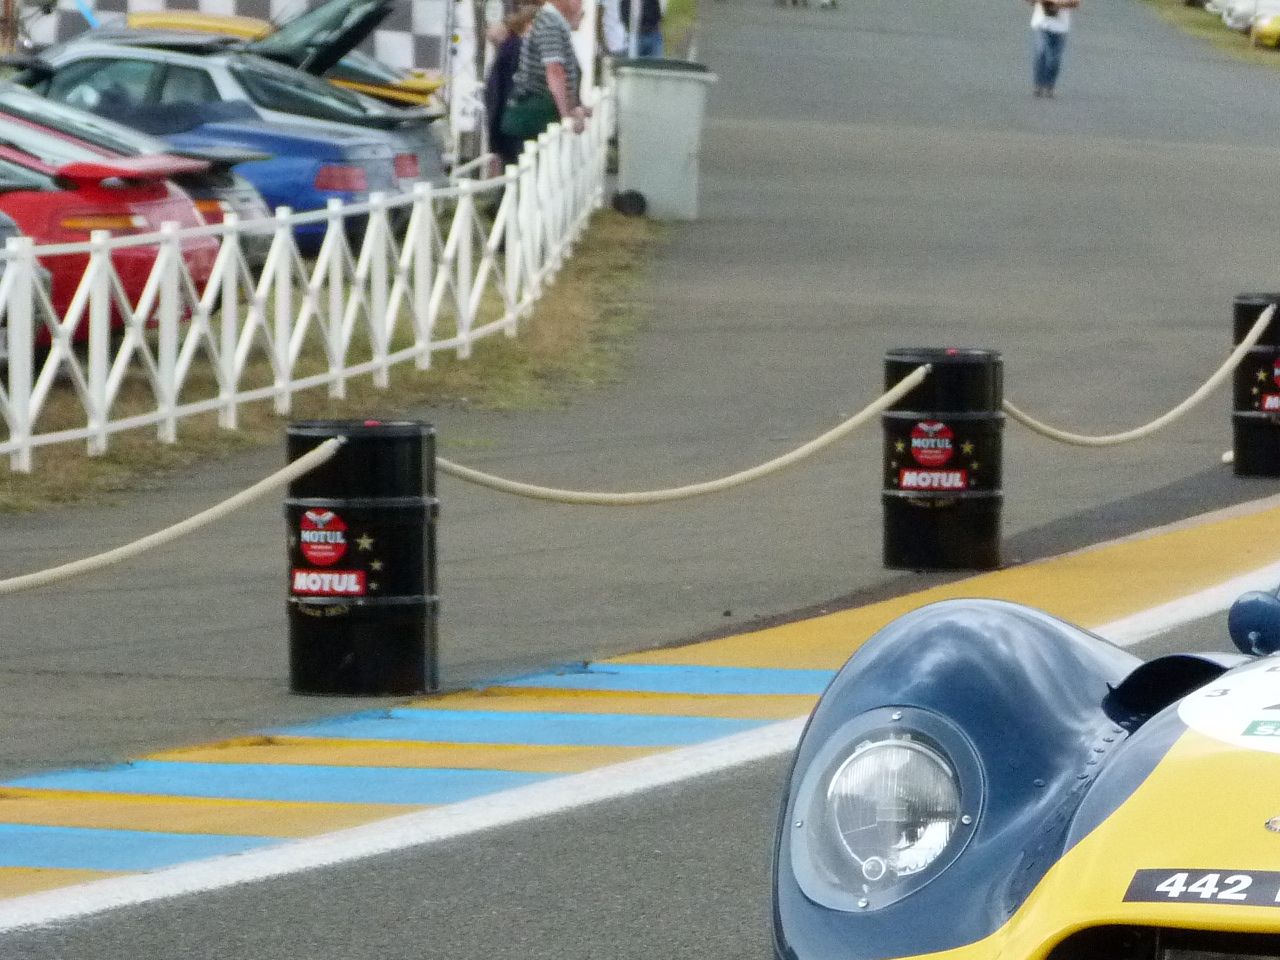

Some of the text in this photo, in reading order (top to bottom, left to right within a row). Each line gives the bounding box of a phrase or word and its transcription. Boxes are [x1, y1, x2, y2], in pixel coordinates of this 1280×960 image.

[911, 438, 952, 449] MOTUL
[903, 471, 964, 488] MOTUL
[301, 530, 346, 543] MOTUL
[293, 571, 361, 592] MOTUL
[1155, 872, 1254, 901] 442
